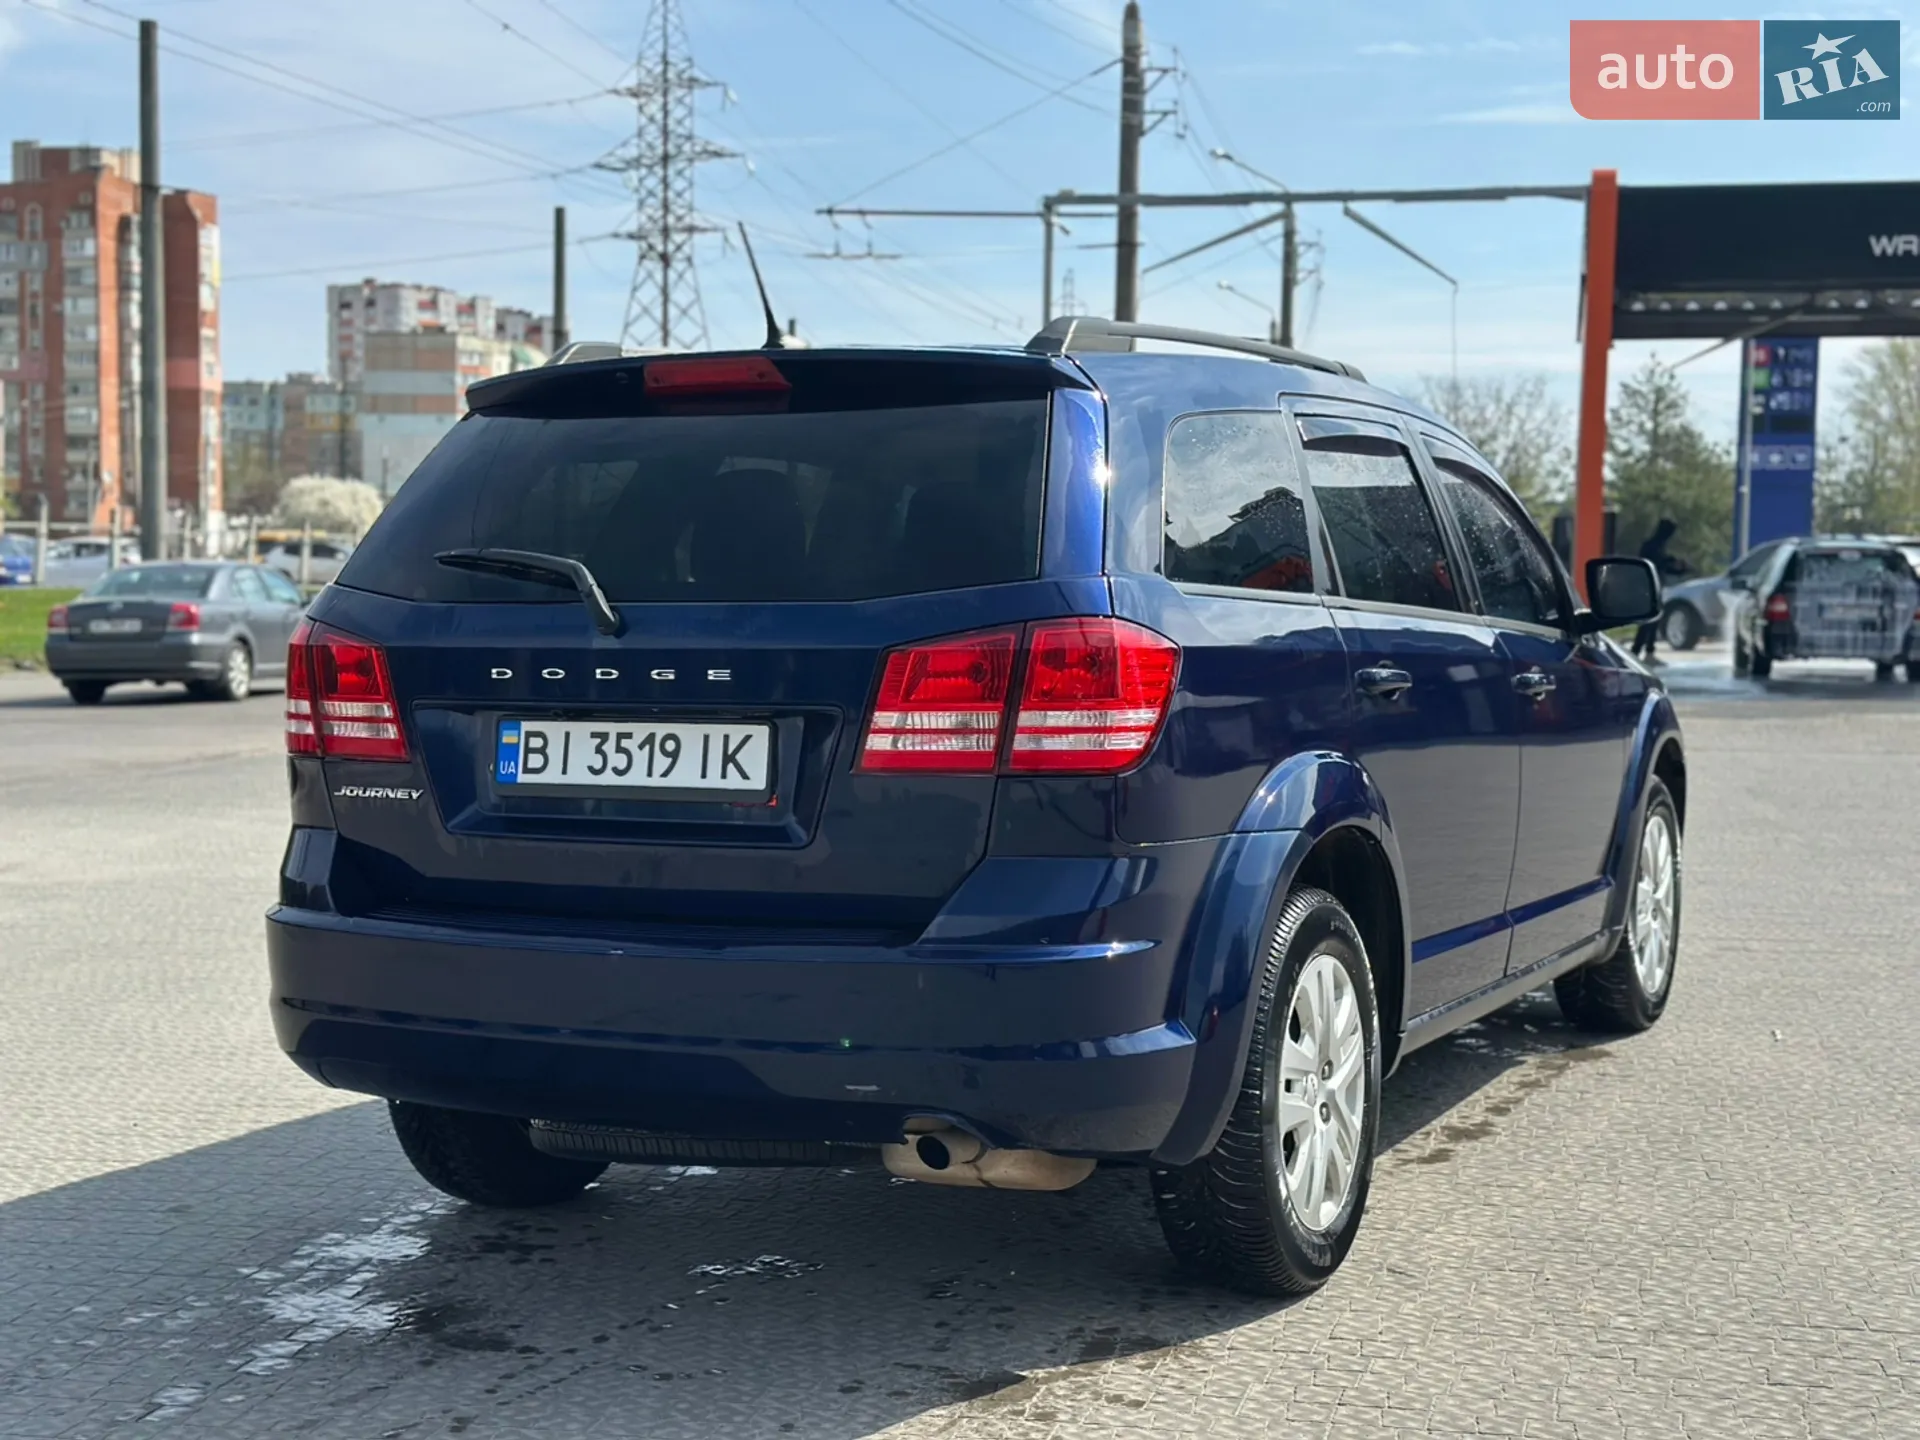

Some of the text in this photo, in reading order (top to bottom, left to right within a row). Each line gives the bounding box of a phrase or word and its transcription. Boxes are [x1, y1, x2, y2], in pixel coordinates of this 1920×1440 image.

[490, 667, 732, 681] DODGE
[521, 730, 754, 781] BI 3519 IK
[499, 760, 517, 775] UA
[333, 785, 425, 800] JOURNEY
